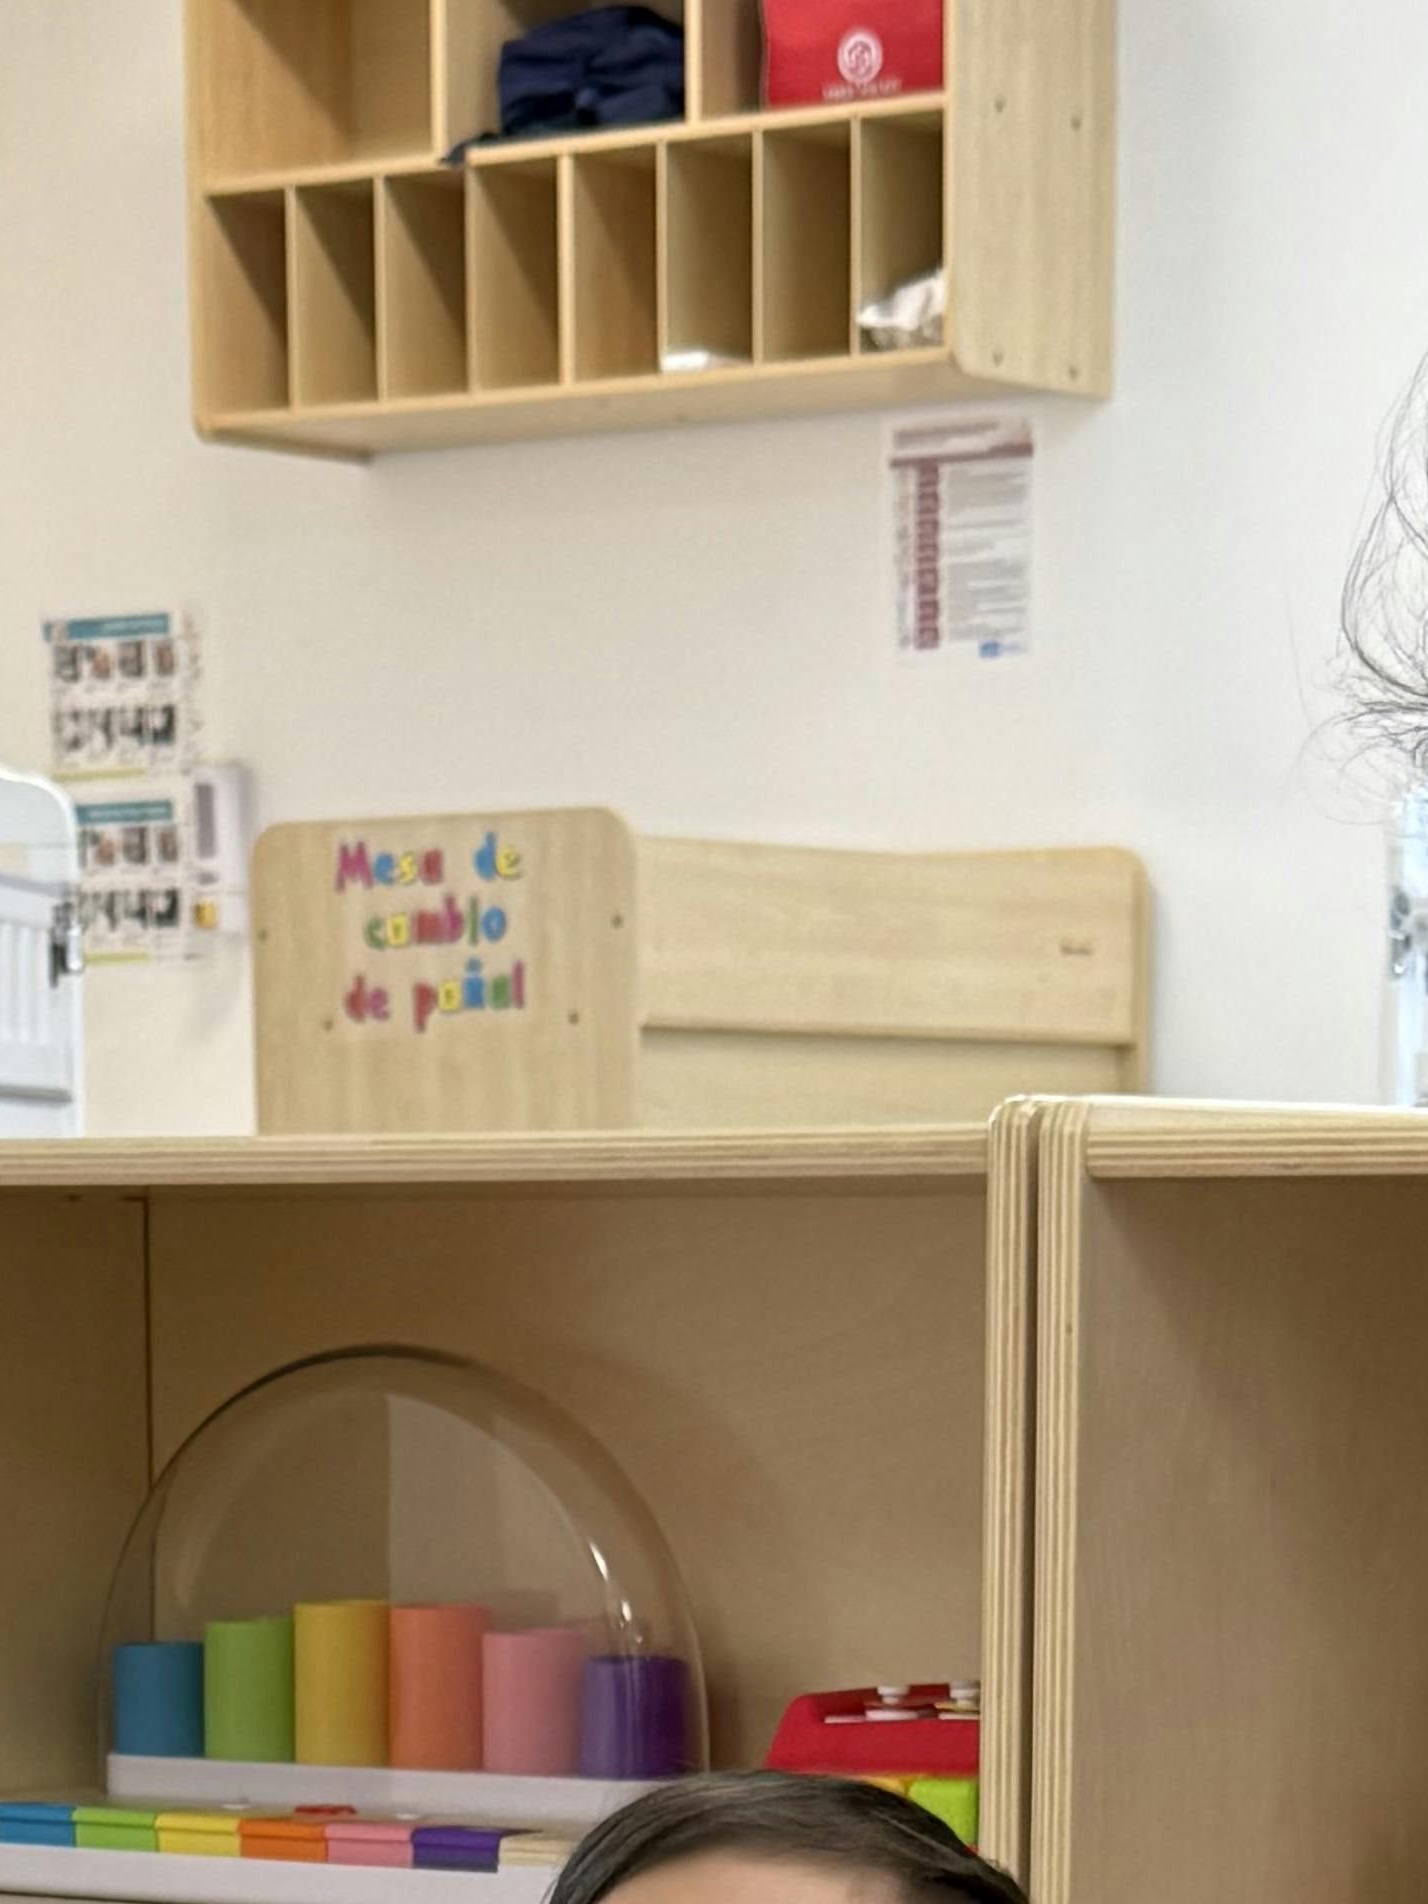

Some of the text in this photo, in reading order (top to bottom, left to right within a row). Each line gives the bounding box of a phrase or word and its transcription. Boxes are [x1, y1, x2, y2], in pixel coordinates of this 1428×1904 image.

[335, 832, 522, 892] Mesa de
[344, 974, 390, 1023] de
